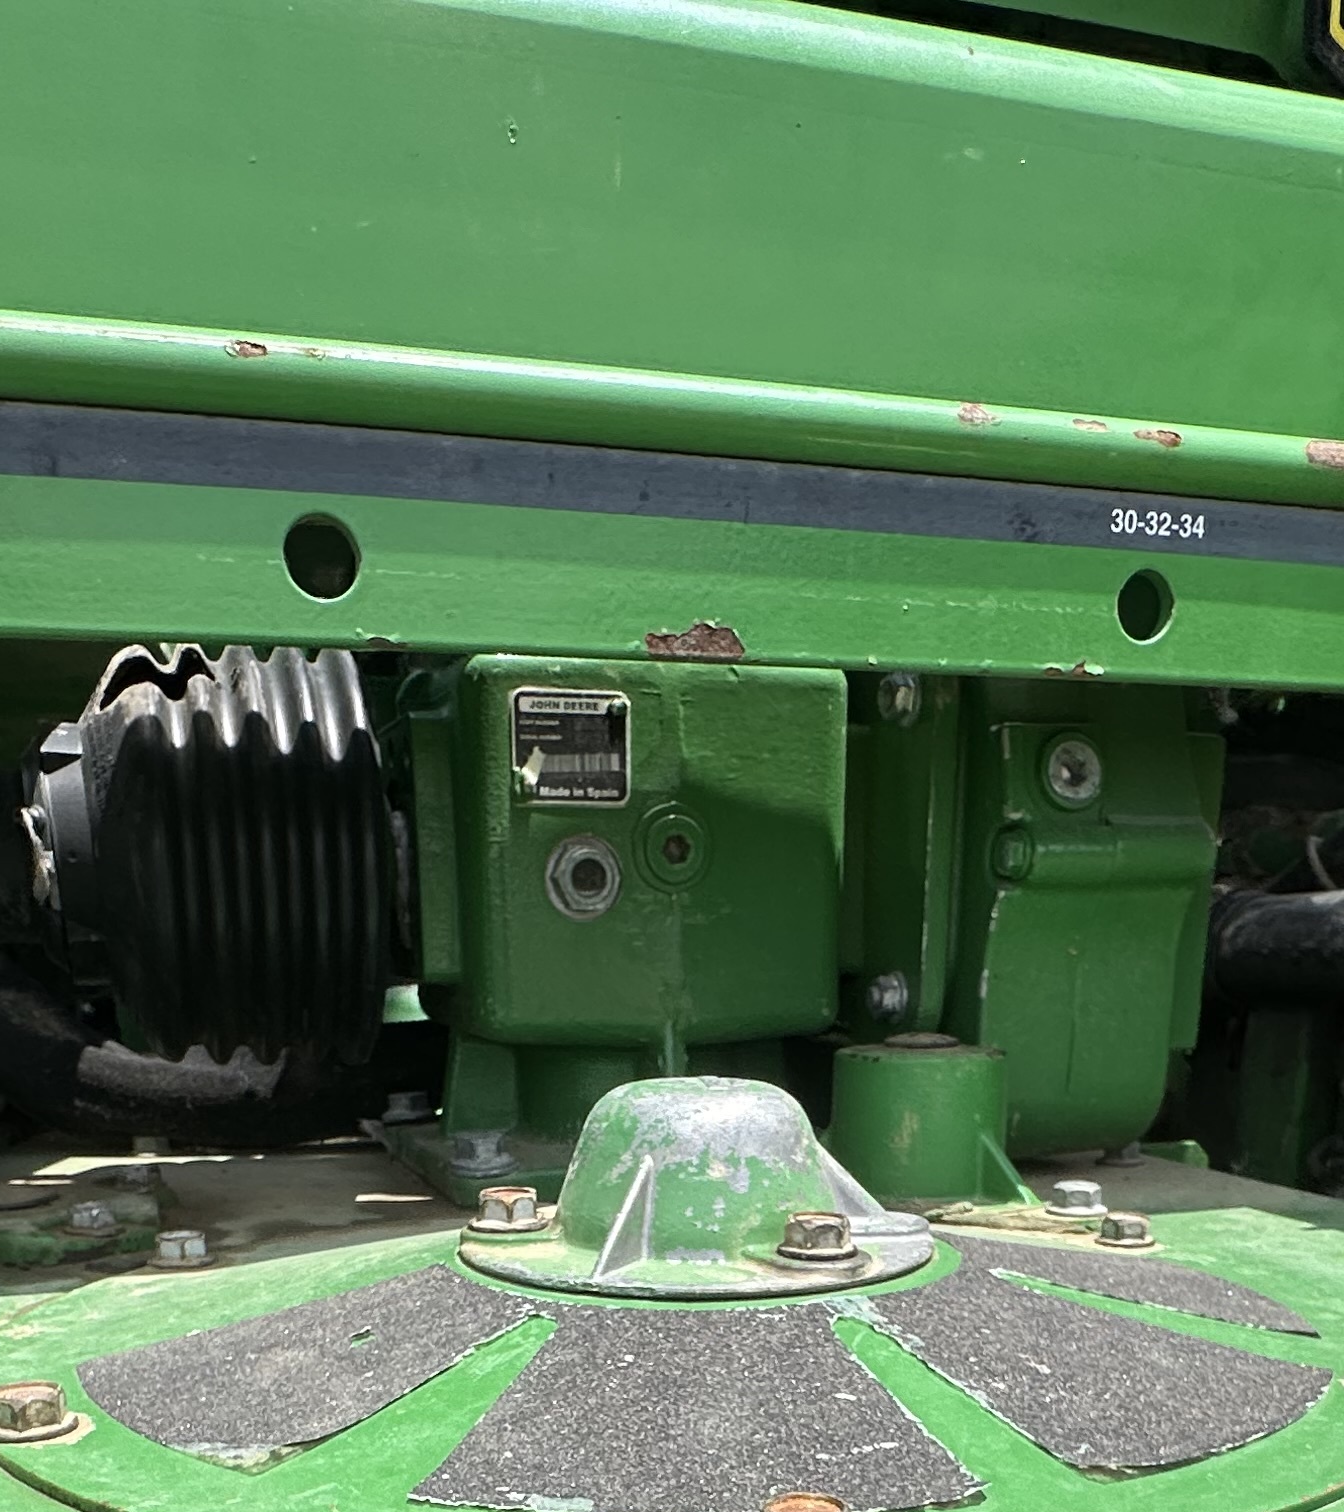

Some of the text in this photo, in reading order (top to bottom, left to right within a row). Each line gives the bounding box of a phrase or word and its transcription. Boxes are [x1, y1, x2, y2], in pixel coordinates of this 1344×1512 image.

[1110, 508, 1205, 539] 30-32-34
[529, 700, 599, 711] JOHN DEERE
[539, 785, 619, 799] Made in Spain
